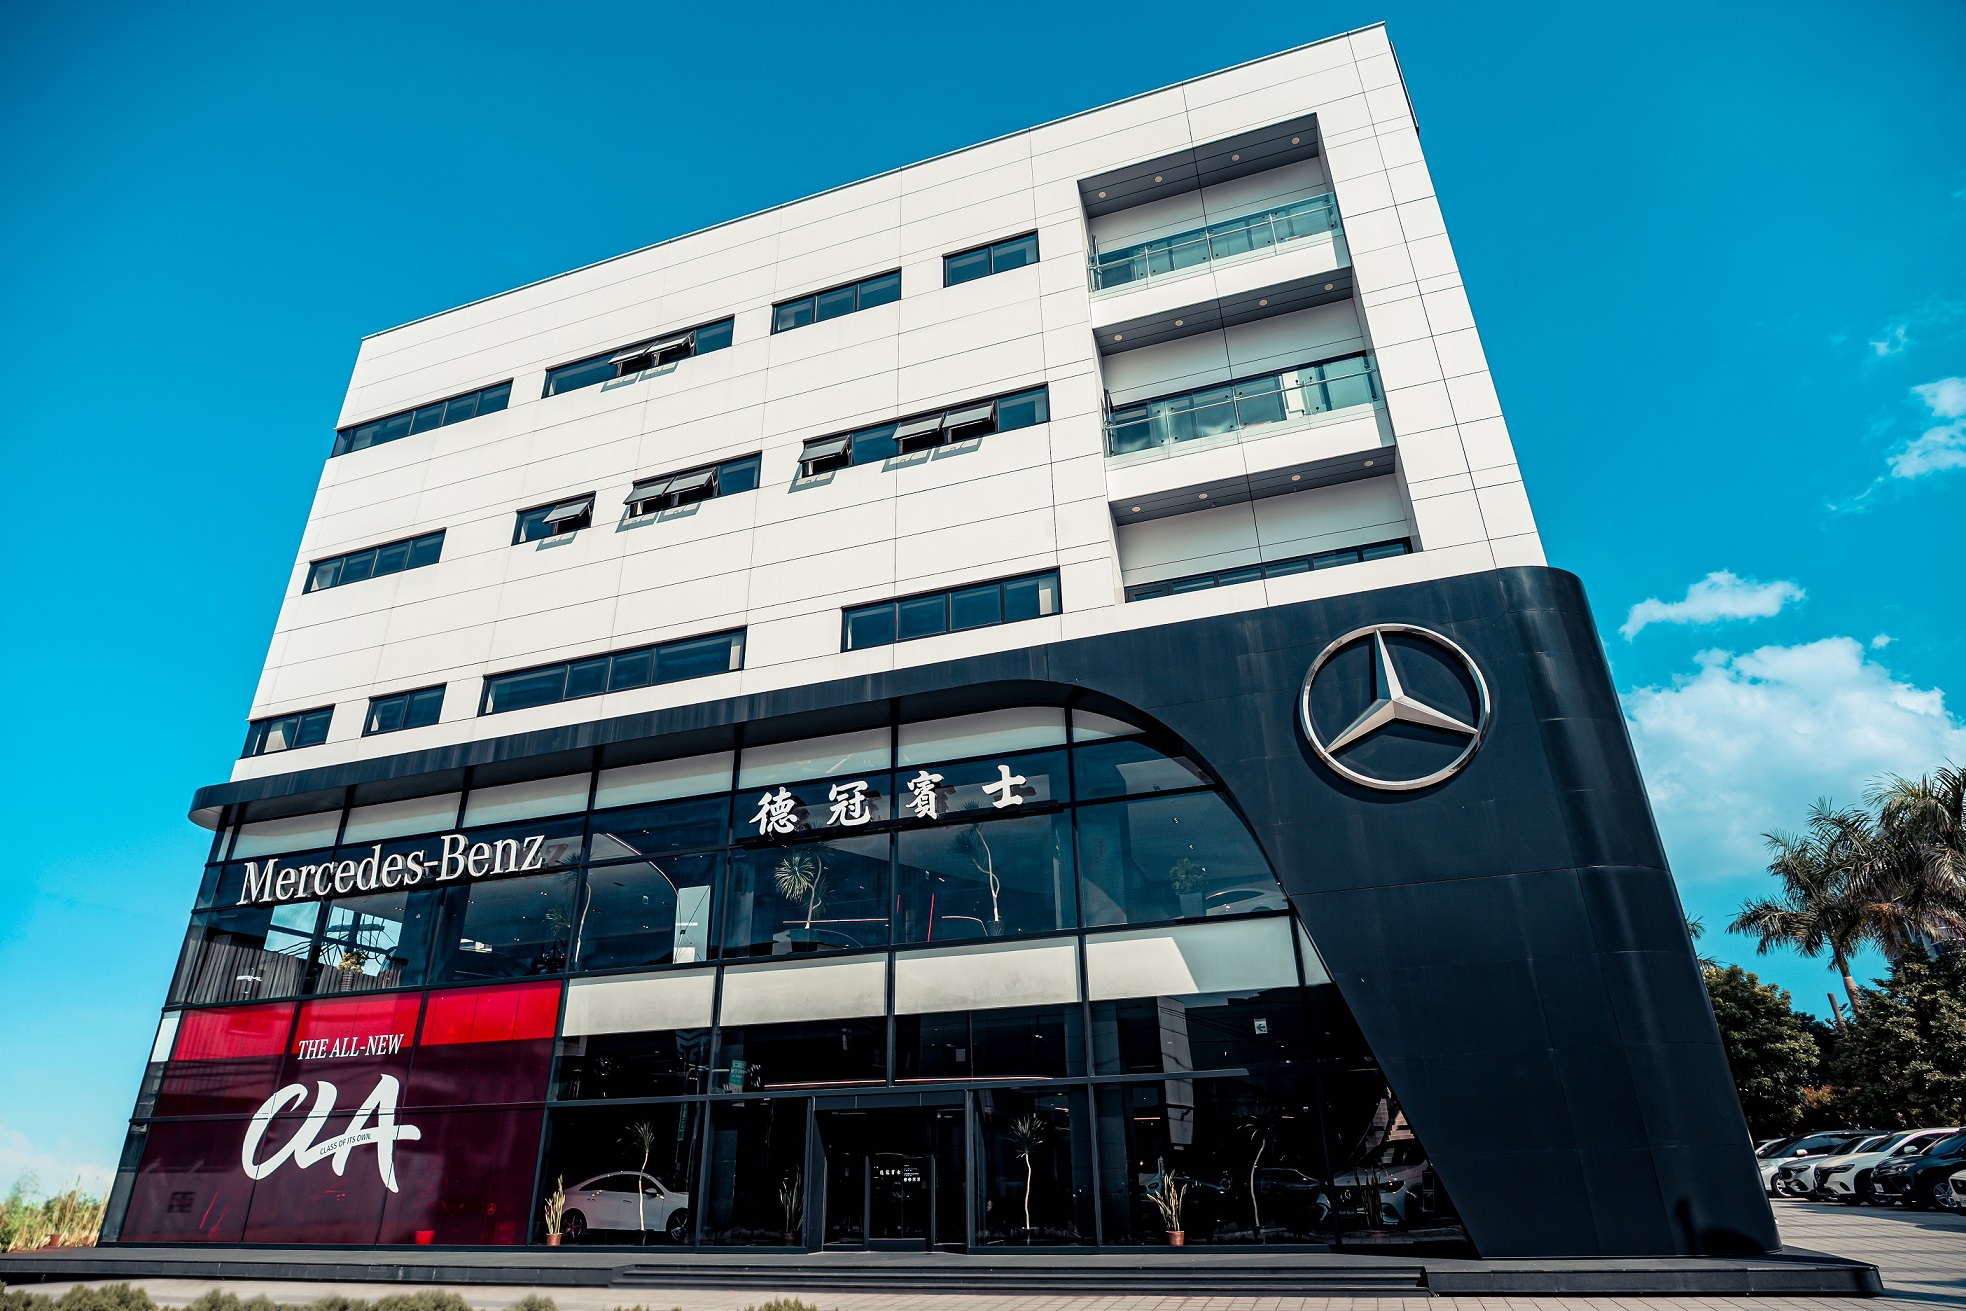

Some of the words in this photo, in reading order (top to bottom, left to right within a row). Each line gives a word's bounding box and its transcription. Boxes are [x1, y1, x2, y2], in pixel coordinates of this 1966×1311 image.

[748, 764, 1028, 836] 德冠賓士
[236, 833, 546, 907] Mercedes-Benz
[297, 1038, 329, 1061] THE
[328, 1033, 405, 1058] ALL-NEW
[241, 1073, 422, 1194] CLA
[320, 1142, 337, 1155] CLASS
[338, 1138, 346, 1147] OF
[347, 1135, 356, 1144] ITS
[357, 1133, 371, 1142] OWN.
